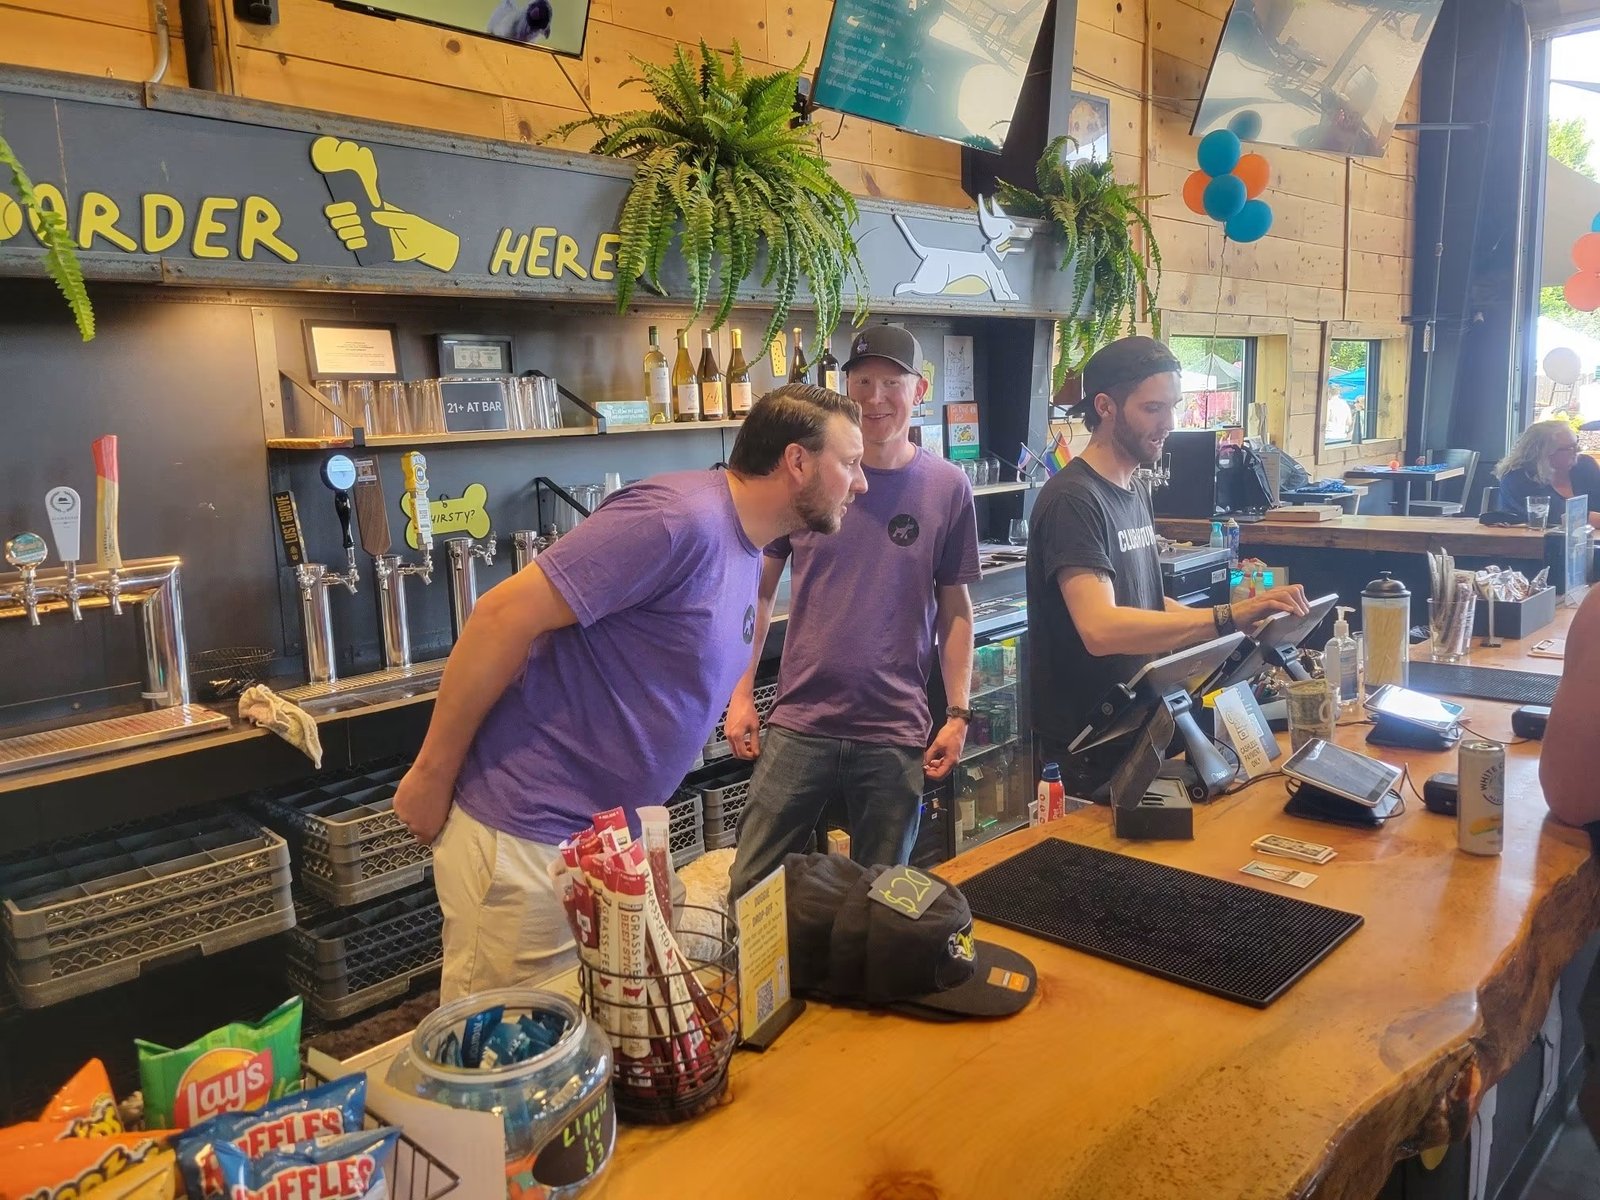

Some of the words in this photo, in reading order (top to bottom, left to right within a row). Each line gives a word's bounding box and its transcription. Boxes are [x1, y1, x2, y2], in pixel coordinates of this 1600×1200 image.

[28, 182, 299, 263] ORDER
[489, 226, 616, 282] HERE
[447, 402, 464, 414] 21+
[467, 401, 480, 412] AT
[482, 400, 502, 412] BAR
[276, 495, 294, 522] GROVE
[430, 509, 476, 524] HIRSTY?
[282, 524, 298, 543] LOST
[1244, 747, 1262, 762] PAYMENT
[1250, 757, 1261, 768] ONLY
[1480, 765, 1498, 791] WHITE
[878, 867, 933, 914] $20
[645, 880, 671, 949] GRASS-FED
[631, 914, 642, 986] GRASS-FED
[187, 1060, 265, 1128] Lay's
